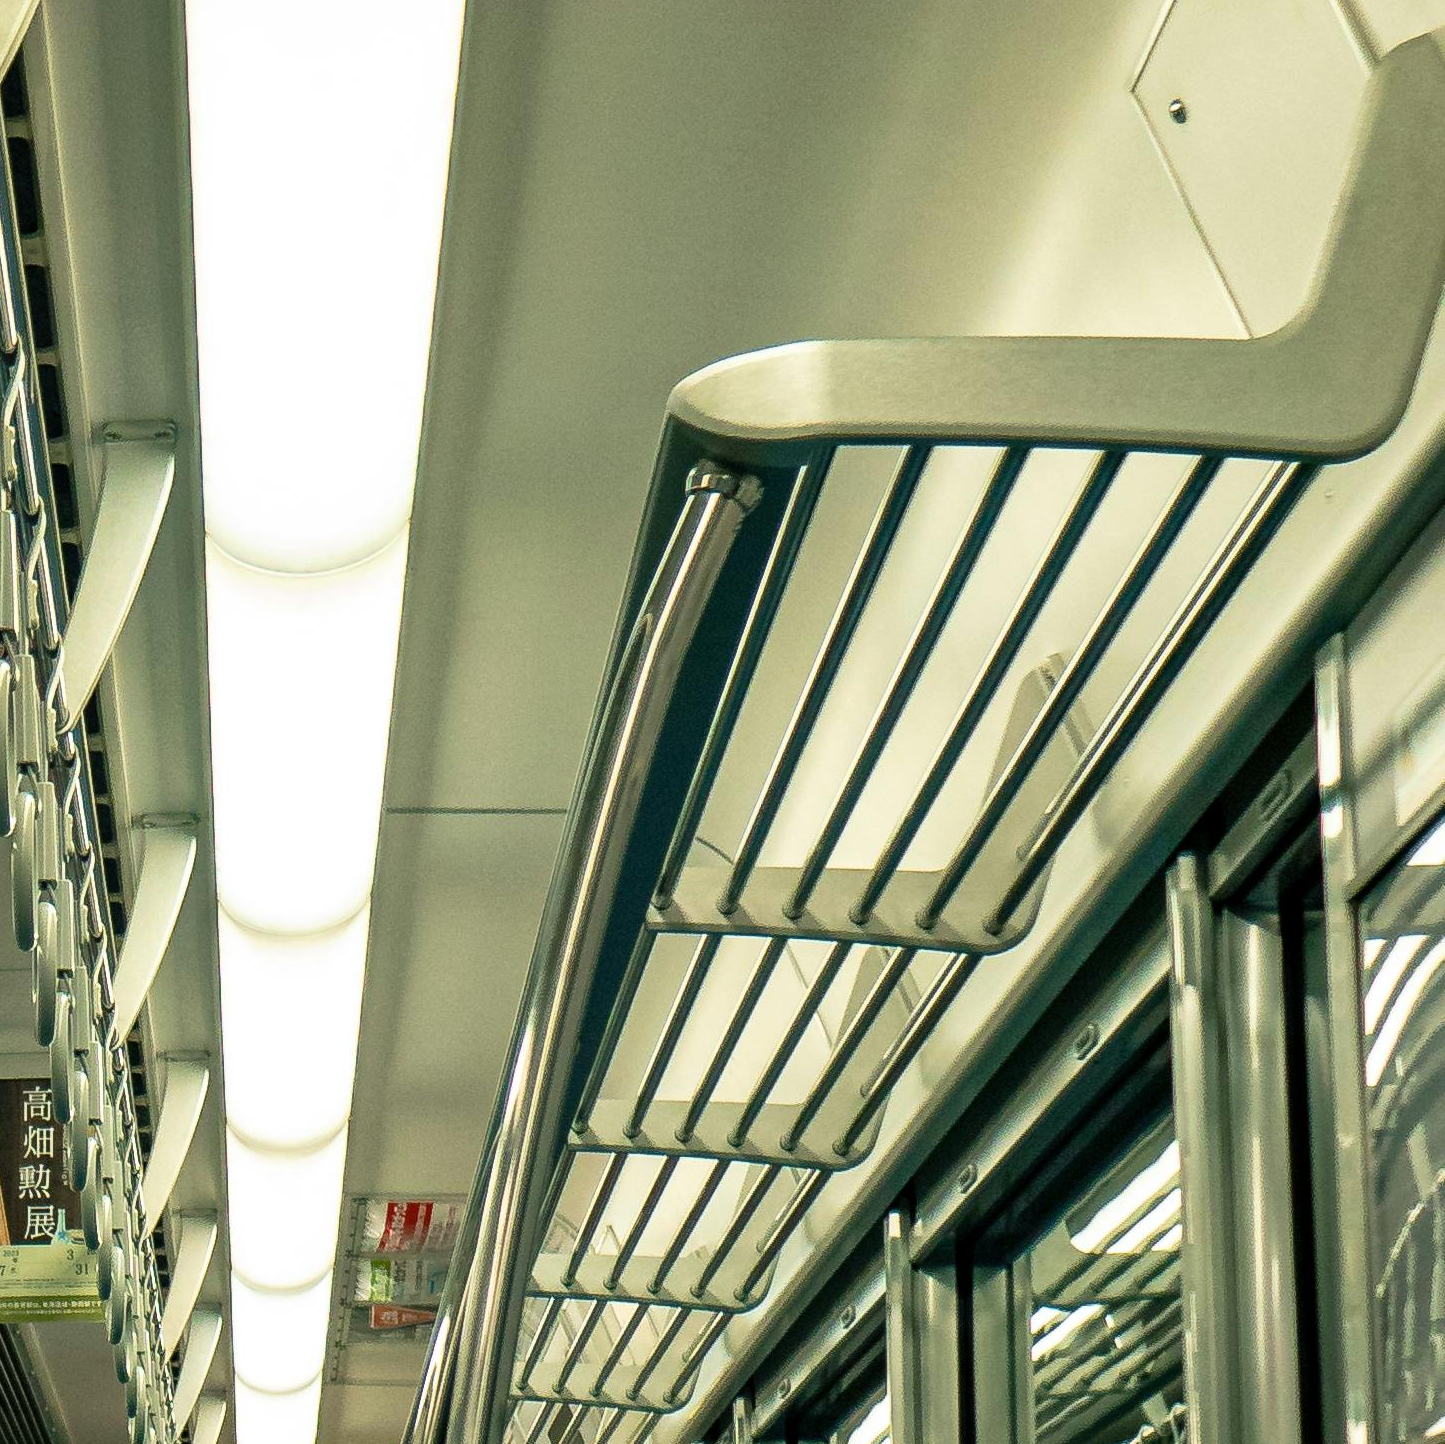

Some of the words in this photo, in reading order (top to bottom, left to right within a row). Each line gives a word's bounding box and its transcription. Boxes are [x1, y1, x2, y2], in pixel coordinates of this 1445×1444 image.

[19, 1086, 55, 1239] 高畑勲展
[67, 1249, 74, 1260] 3
[75, 1264, 88, 1276] 31
